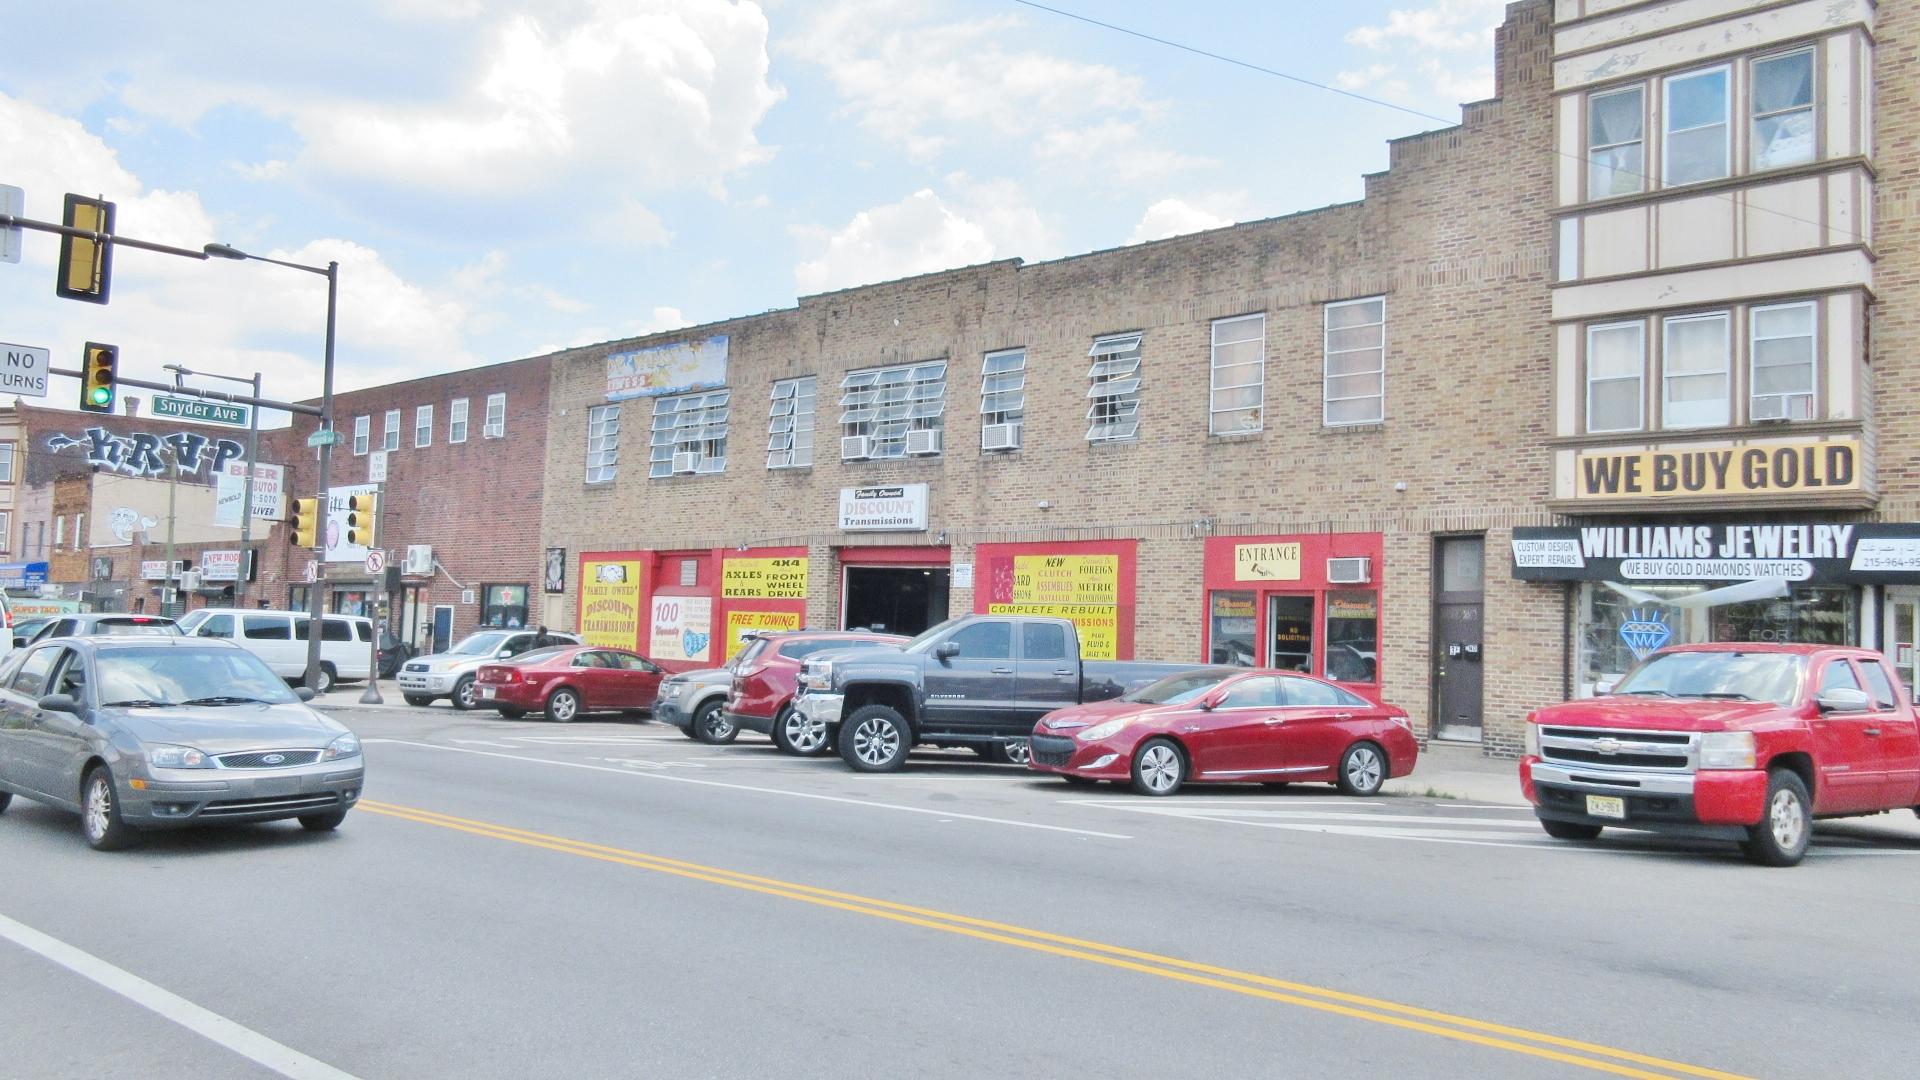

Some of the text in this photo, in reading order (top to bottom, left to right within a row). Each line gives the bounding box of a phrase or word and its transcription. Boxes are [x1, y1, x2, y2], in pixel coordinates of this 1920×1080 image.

[7, 351, 34, 368] NO
[160, 399, 238, 420] Snyder Ave
[1583, 445, 1854, 494] WE BUY GOLD
[855, 489, 902, 499] Family Owned
[845, 500, 914, 515] DISCOUNT
[844, 516, 914, 525] Transmissions
[1581, 524, 1854, 559] WILLIAMS JEWELRY
[1517, 542, 1574, 552] CUSTOM DESIGN
[224, 552, 241, 563] HOP
[1239, 546, 1298, 562] ENTRANCE
[1045, 558, 1065, 567] NEW
[1519, 554, 1577, 565] EXPERT REPAIRS
[1079, 565, 1113, 574] FOREIGN
[1626, 562, 1804, 577] WE BUY GOLD DIAMONDS WATCHES
[725, 571, 762, 579] AXLES
[766, 573, 805, 581] FRONT
[725, 588, 761, 596] REARS
[1036, 582, 1073, 592] ASSEMBLIES
[1078, 583, 1114, 592] METRIC
[768, 590, 803, 598] DRIVE
[1038, 594, 1070, 602] INSTALLED
[585, 599, 634, 619] DISCOUNT
[655, 603, 679, 622] 100
[991, 605, 1115, 615] COMPLETE REBUILT
[730, 614, 796, 627] FREE TOWING
[584, 620, 635, 633] TRANSMISSIONS
[1086, 640, 1104, 648] FLUID
